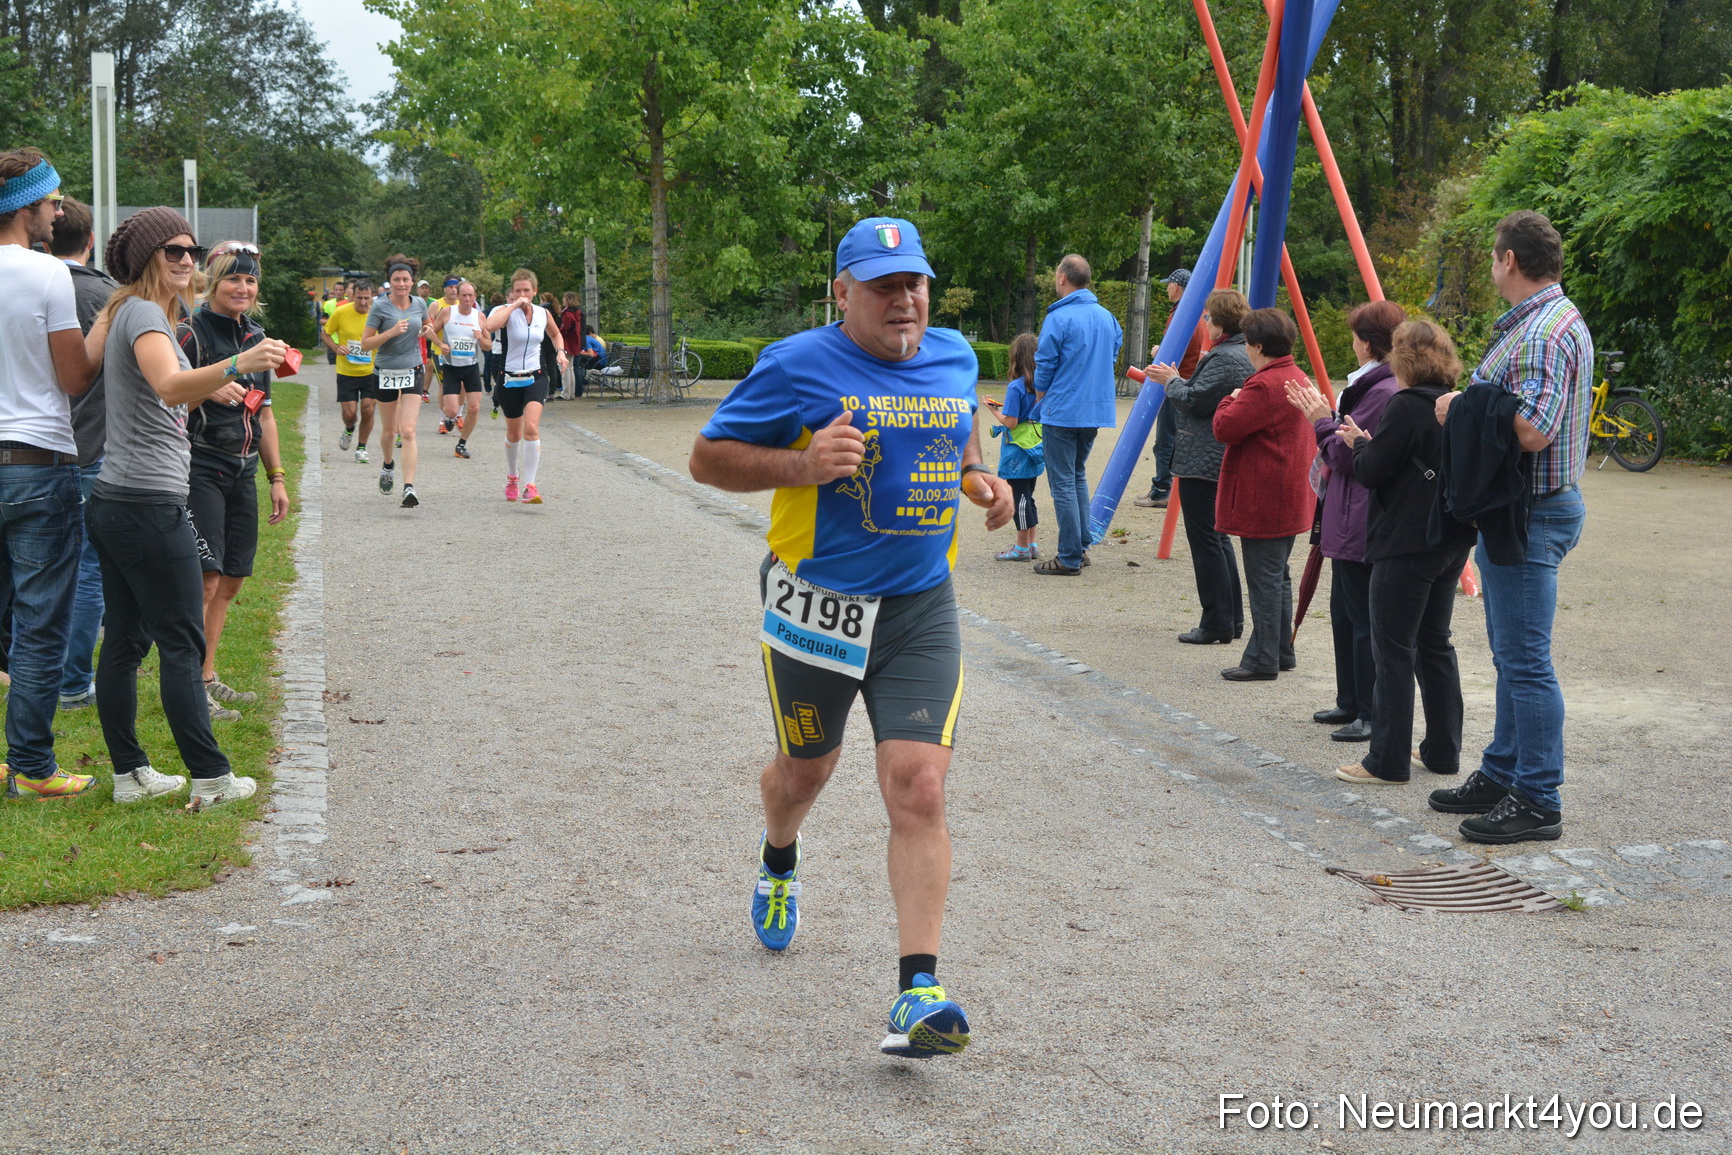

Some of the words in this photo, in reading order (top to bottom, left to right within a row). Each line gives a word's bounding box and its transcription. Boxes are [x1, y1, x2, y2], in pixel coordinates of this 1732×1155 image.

[453, 341, 474, 351] 2057
[383, 376, 411, 388] 2173
[839, 396, 866, 411] 10.
[868, 396, 971, 414] NEUMARKTER
[867, 411, 959, 428] STADTLAUF
[808, 583, 861, 602] Neumarkt
[775, 579, 864, 639] 2198
[777, 622, 847, 660] Pascquale
[798, 708, 820, 738] Run!
